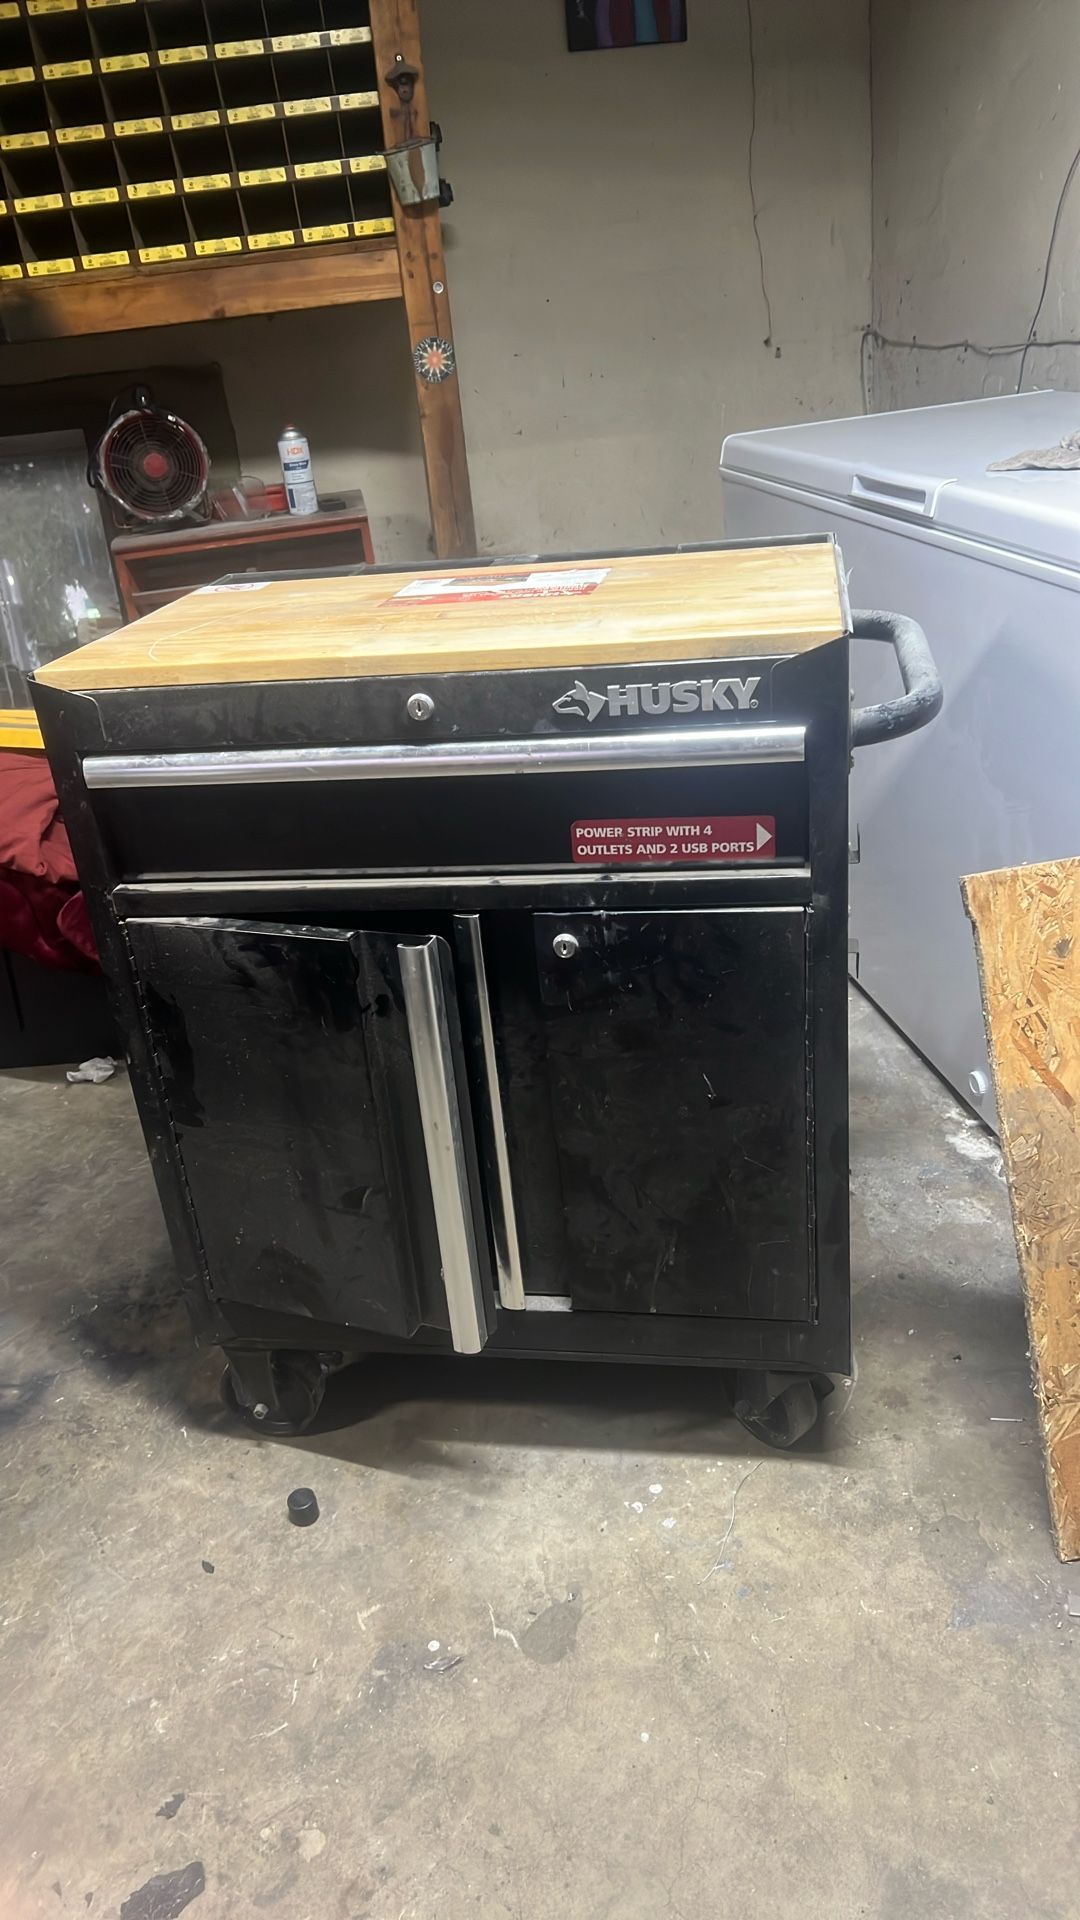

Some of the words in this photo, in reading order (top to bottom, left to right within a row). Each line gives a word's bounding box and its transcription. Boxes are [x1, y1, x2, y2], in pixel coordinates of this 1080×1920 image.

[576, 827, 623, 838] POWER
[627, 826, 662, 837] STRIP
[666, 825, 700, 836] WITH
[703, 825, 712, 835] 4
[577, 844, 633, 855] OUTLETS
[636, 844, 666, 854] AND
[670, 843, 678, 854] 2
[681, 843, 708, 853] USB
[711, 841, 755, 853] PORTS
